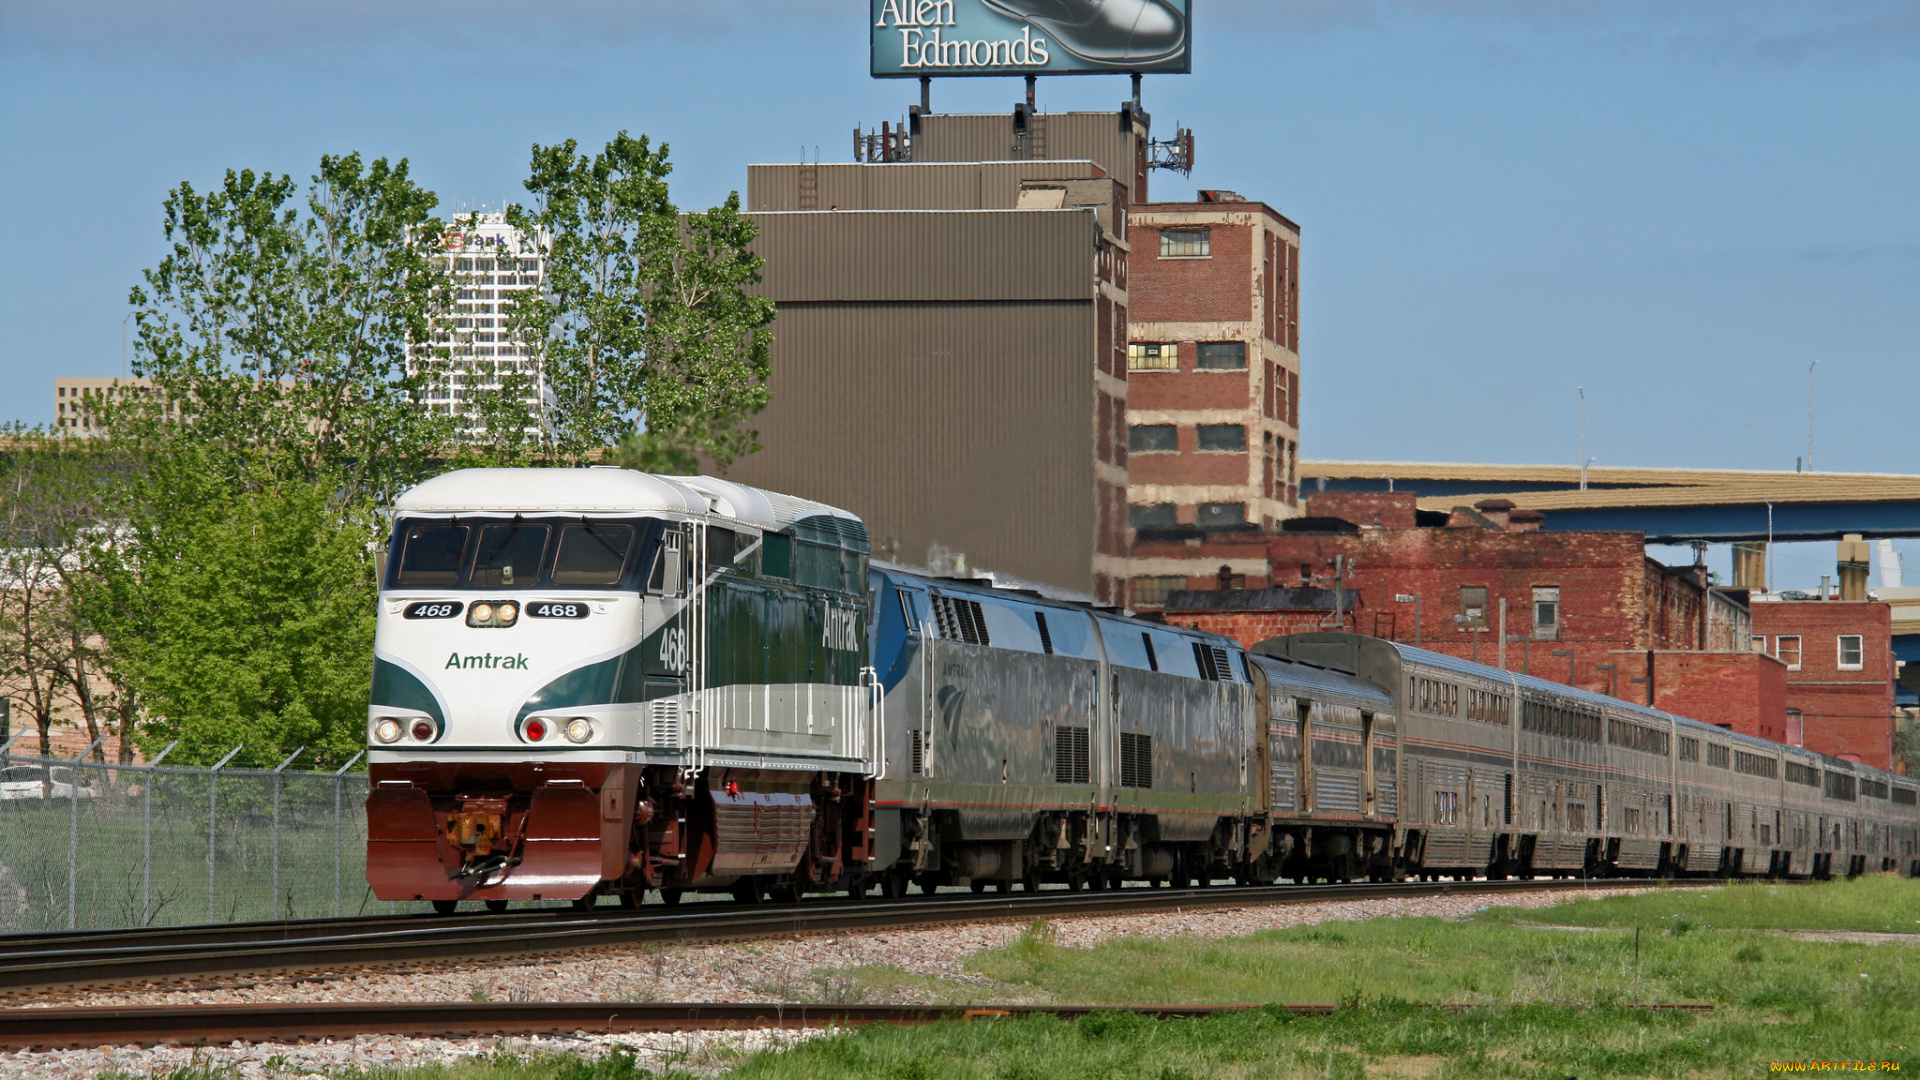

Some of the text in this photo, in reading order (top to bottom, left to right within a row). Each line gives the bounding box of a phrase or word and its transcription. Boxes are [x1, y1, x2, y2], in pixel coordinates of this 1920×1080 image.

[875, 0, 956, 27] Allen
[899, 26, 1049, 68] Edmonds
[414, 604, 452, 617] 468
[538, 604, 578, 617] 468
[660, 627, 685, 671] 468
[444, 652, 529, 669] Amtrak
